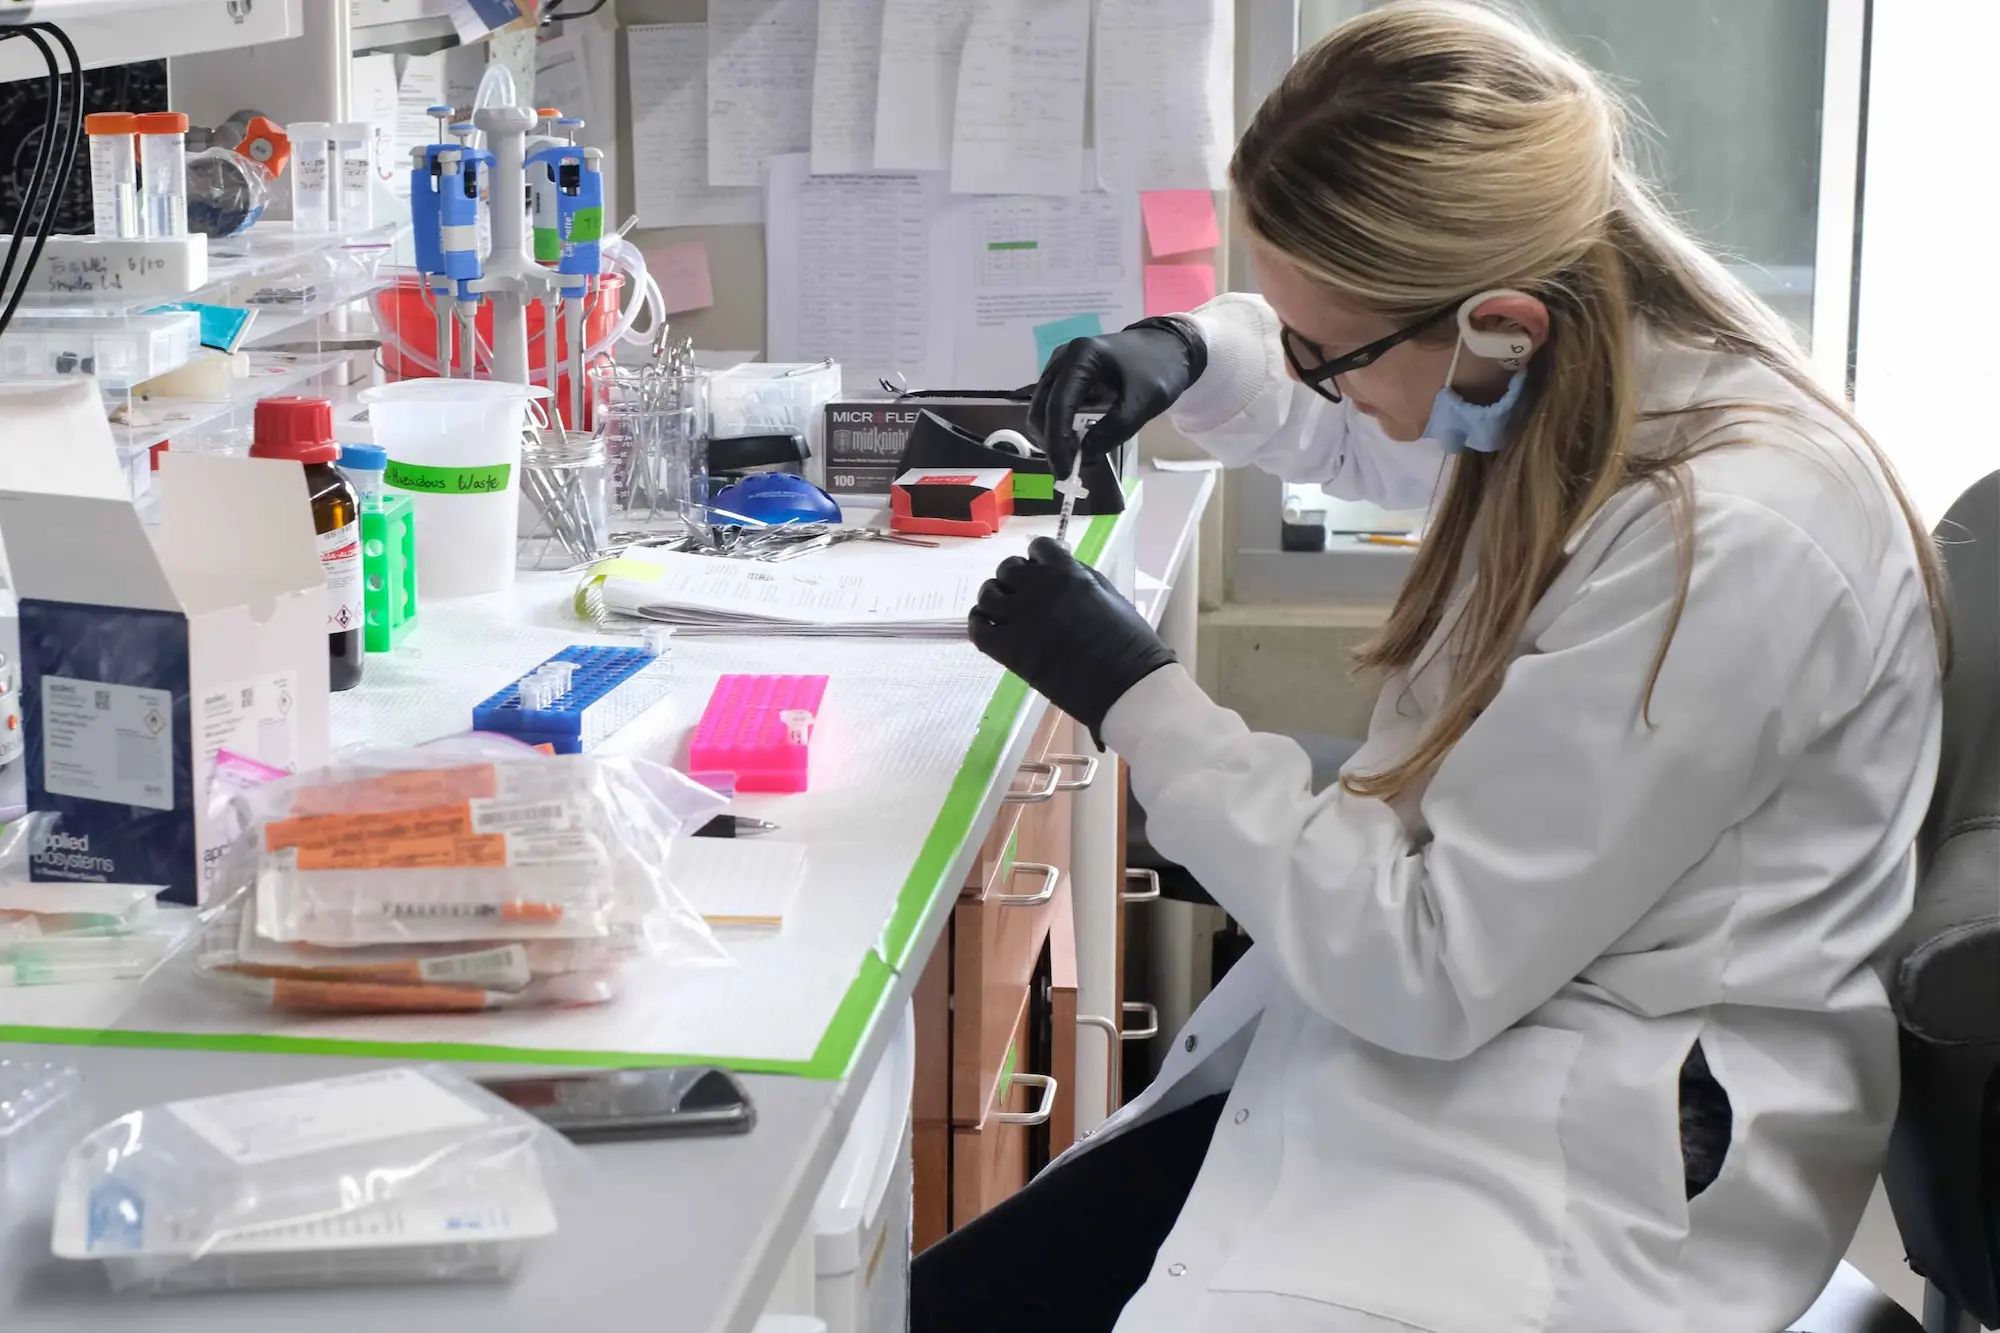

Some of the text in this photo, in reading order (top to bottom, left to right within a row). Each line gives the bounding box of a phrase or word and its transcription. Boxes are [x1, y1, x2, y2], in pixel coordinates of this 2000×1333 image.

[458, 474, 499, 492] Waste
[833, 475, 855, 487] 100
[45, 832, 89, 851] pplied
